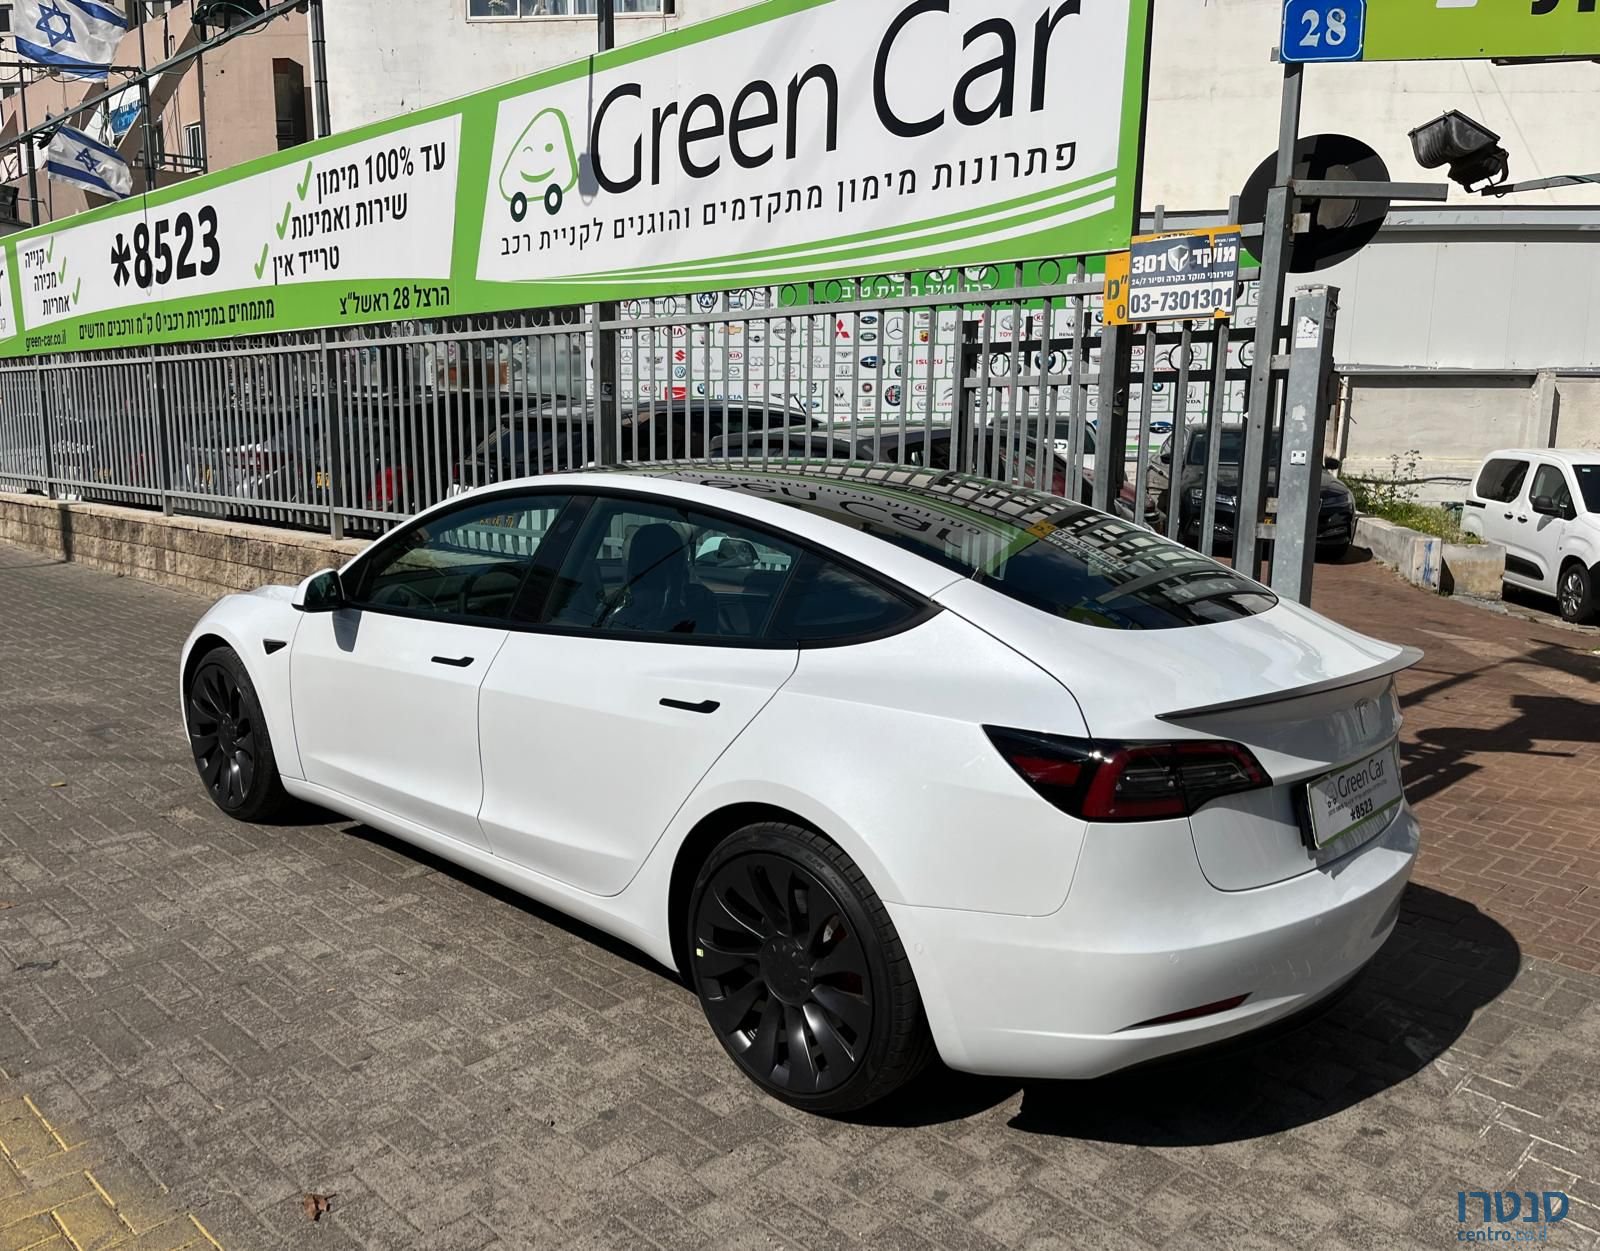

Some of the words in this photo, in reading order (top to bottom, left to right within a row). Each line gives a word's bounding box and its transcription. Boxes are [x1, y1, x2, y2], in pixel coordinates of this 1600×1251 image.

[1299, 8, 1347, 47] 28
[591, 62, 838, 194] Green
[872, 0, 1082, 137] Car
[365, 146, 414, 184] 100%
[420, 142, 446, 172] עד
[932, 141, 1076, 190] פתרונות
[316, 163, 359, 204] מימון
[837, 169, 916, 213] מימון
[356, 192, 408, 227] שירות
[703, 185, 823, 225] מתקדמים
[292, 205, 350, 240] ואמינות
[539, 217, 604, 251] לקניית
[613, 207, 690, 240] והוגנים
[501, 234, 531, 255] רכב
[1192, 243, 1237, 268] מוקד
[25, 248, 45, 270] קנייה
[273, 253, 295, 286] אין
[299, 245, 340, 274] טרייד
[1131, 253, 1168, 274] 301
[34, 271, 57, 291] מכירה
[43, 295, 70, 316] אחריות
[228, 298, 274, 323] מתמחים
[393, 286, 410, 310] 28
[413, 284, 450, 309] הרצל
[1130, 287, 1233, 314] 03-7301301
[79, 322, 106, 340] חדשים
[107, 319, 134, 337] ורכבים
[156, 312, 161, 332] 0
[164, 312, 184, 331] רכבי
[187, 306, 225, 328] במכירת
[1337, 768, 1369, 798] Green
[1368, 759, 1384, 781] Car
